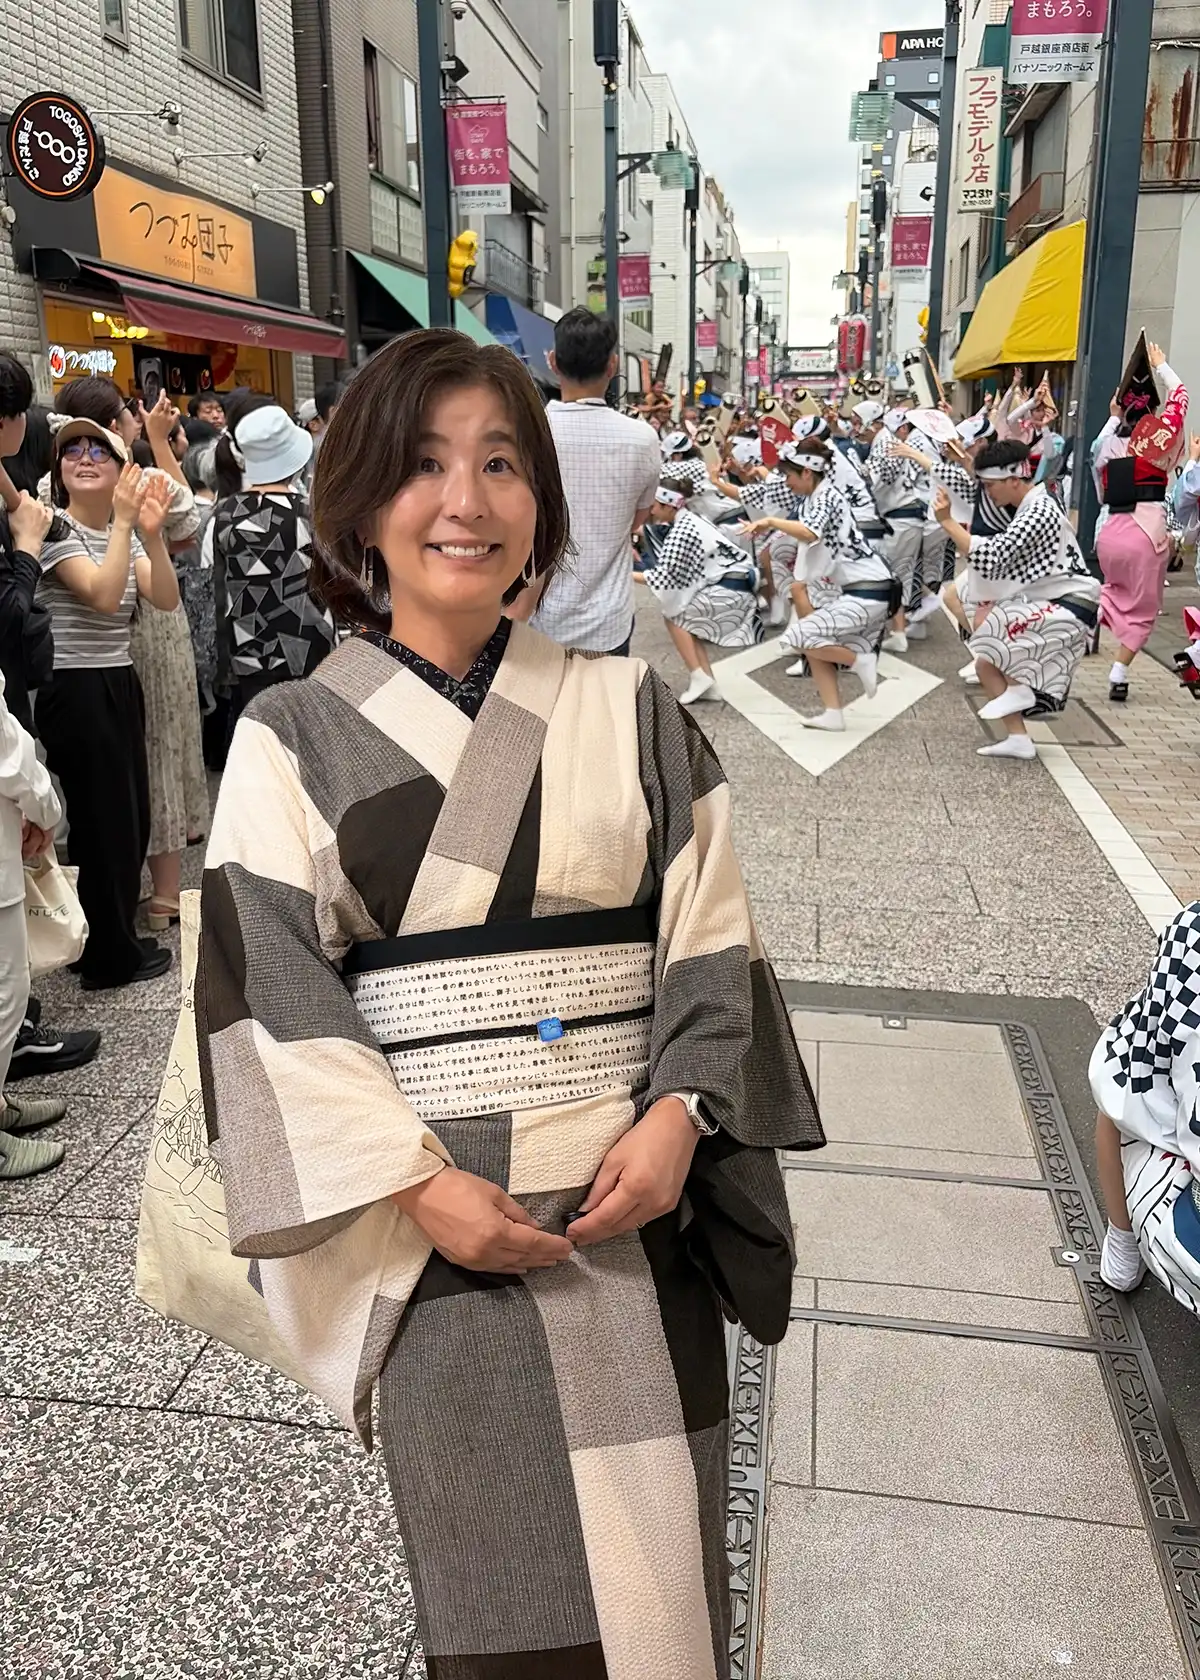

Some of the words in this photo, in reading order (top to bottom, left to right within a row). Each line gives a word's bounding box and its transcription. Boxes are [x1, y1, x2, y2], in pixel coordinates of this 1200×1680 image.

[1027, 0, 1092, 18] まもろう。
[901, 38, 925, 50] APA
[1020, 42, 1090, 54] 戸越銀座商店街
[1013, 63, 1062, 73] パナソニック
[49, 106, 87, 146] TOGOSHI
[964, 75, 998, 184] プラモデルの店
[18, 117, 39, 180] 戸越だんご
[62, 147, 88, 186] DANGO
[460, 164, 500, 175] まもろう。
